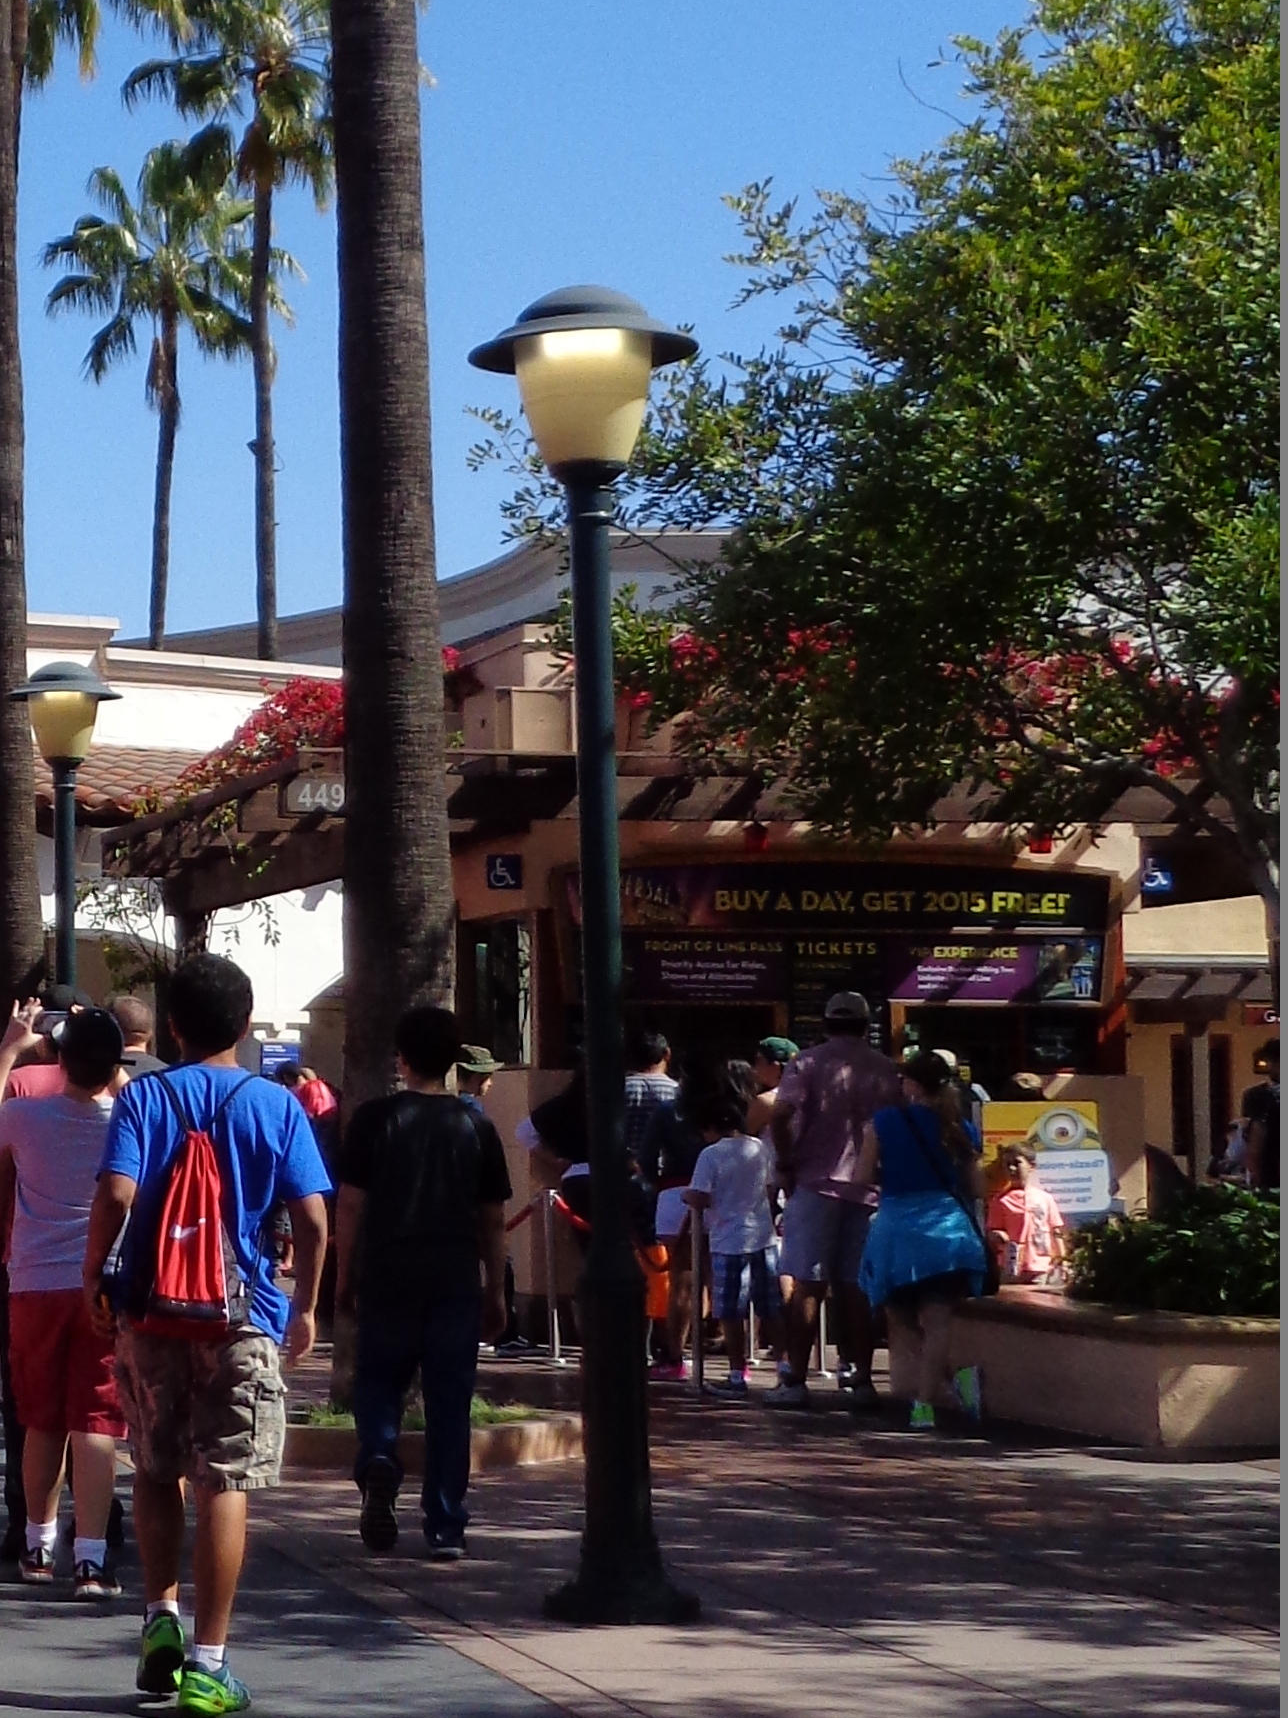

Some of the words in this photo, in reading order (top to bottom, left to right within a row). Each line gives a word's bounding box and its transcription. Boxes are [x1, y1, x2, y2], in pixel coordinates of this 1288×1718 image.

[715, 889, 770, 912] BUY
[774, 891, 794, 912] A
[801, 890, 855, 914] DAY,
[862, 891, 915, 913] GET
[922, 890, 989, 913] 2015
[645, 940, 690, 952] FRONT
[694, 940, 712, 952] OF
[716, 941, 746, 952] LINE
[749, 942, 783, 952] PASS
[796, 941, 877, 955] TICKETS
[933, 945, 1019, 958] EXPERIENCE
